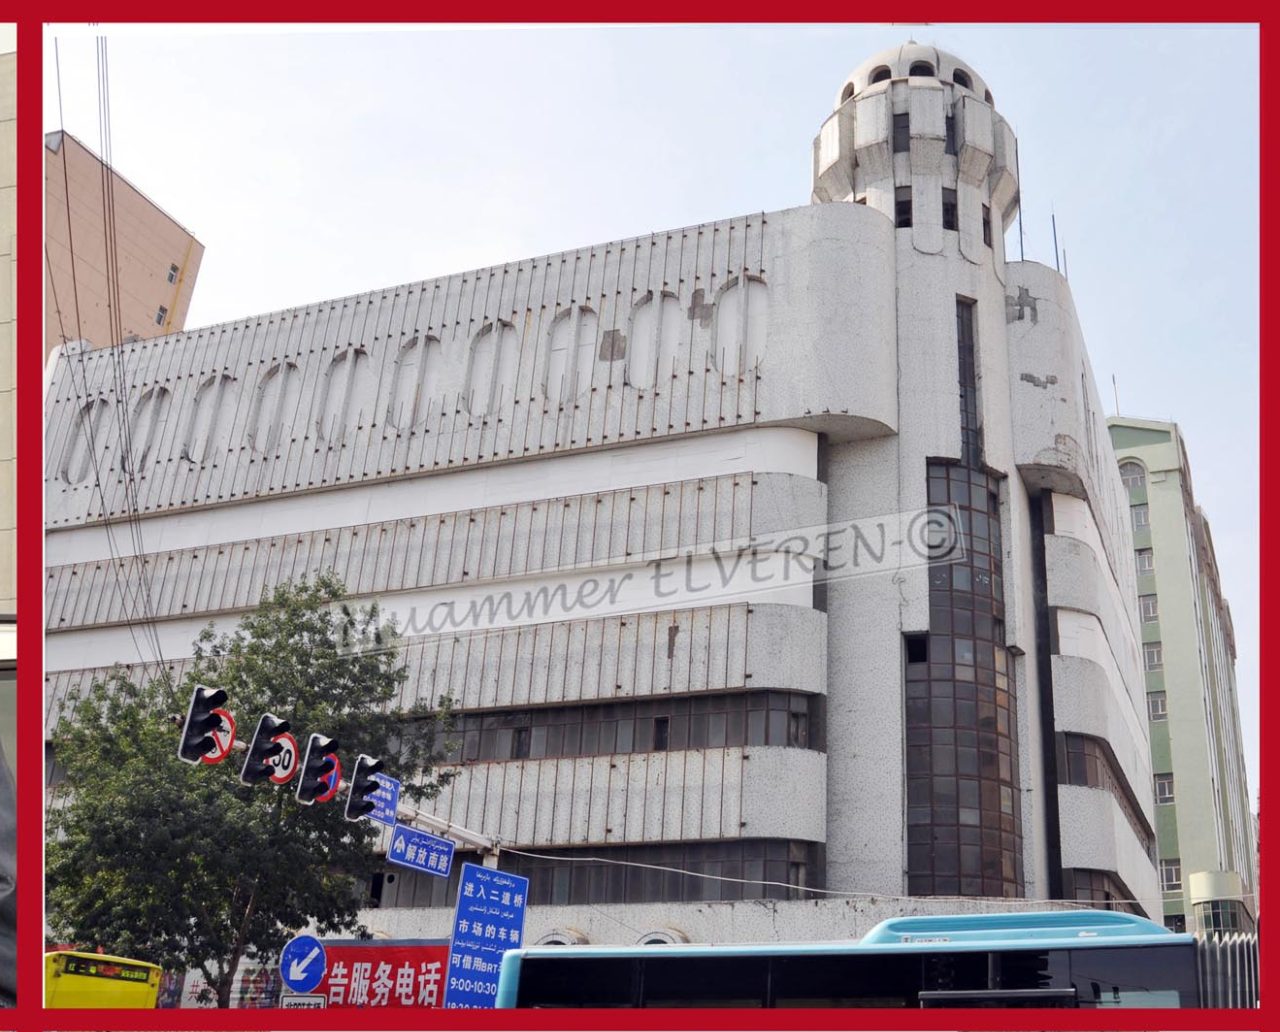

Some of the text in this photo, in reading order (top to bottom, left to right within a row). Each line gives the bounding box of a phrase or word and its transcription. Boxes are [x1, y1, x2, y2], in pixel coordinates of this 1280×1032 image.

[405, 844, 449, 873] 解放南路
[464, 882, 523, 908] 进入二道桥
[458, 919, 520, 943] 市场的车辆
[323, 960, 442, 1007] 告服务电话
[450, 977, 497, 995] 9:00-10:30
